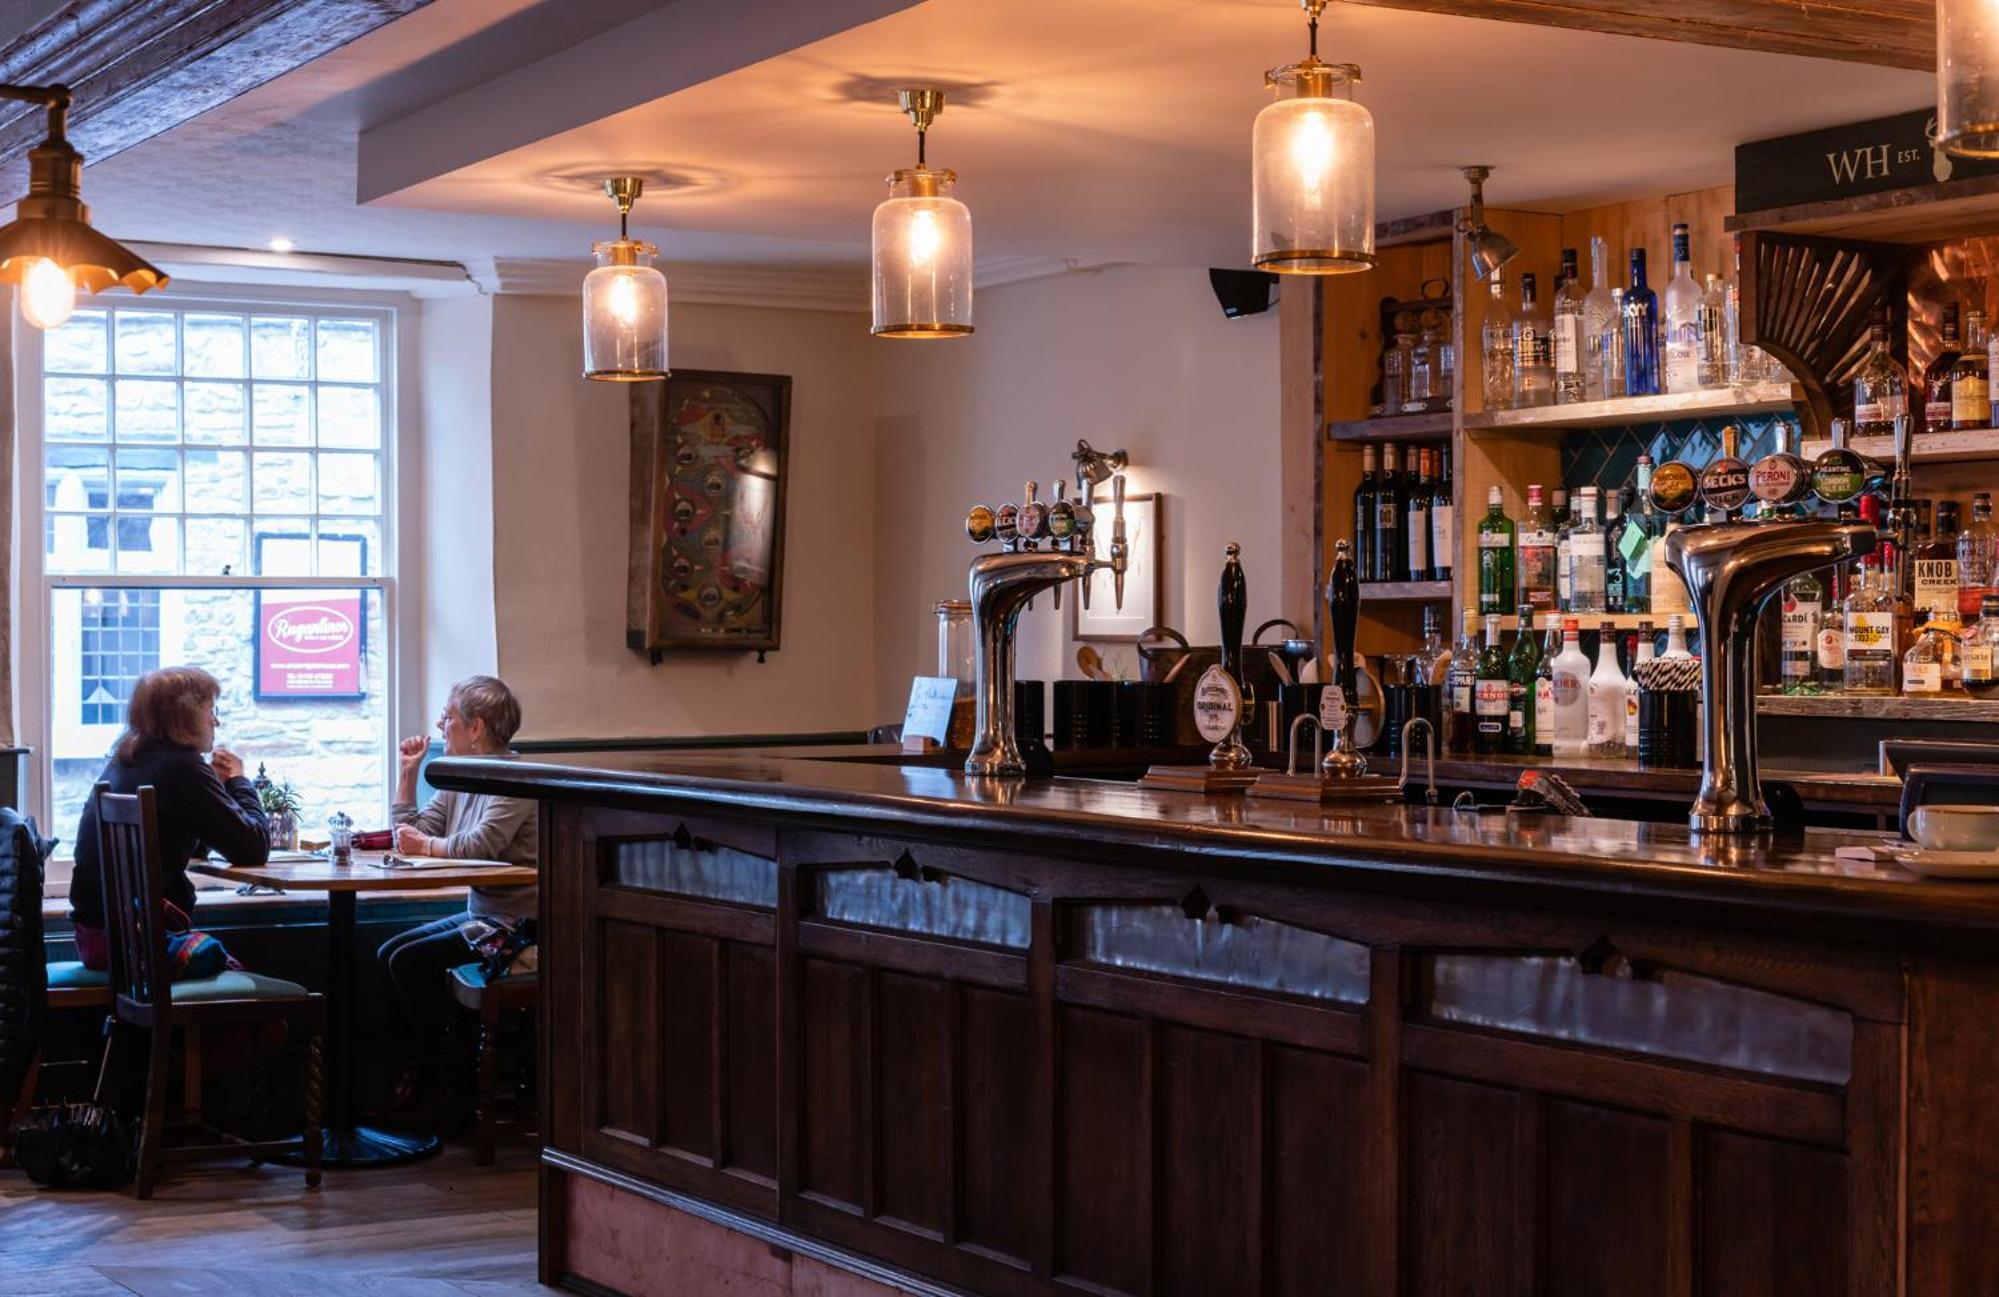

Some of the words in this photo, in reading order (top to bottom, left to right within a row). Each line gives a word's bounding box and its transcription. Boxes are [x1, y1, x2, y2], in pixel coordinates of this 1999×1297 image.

[1825, 144, 1893, 185] WH
[1898, 149, 1920, 164] EST.
[1756, 470, 1791, 483] PERONI
[1918, 561, 1952, 578] KNOB
[1849, 625, 1873, 634] MOUNT
[1875, 625, 1890, 634] GAY
[1197, 701, 1234, 712] ORIGINAL
